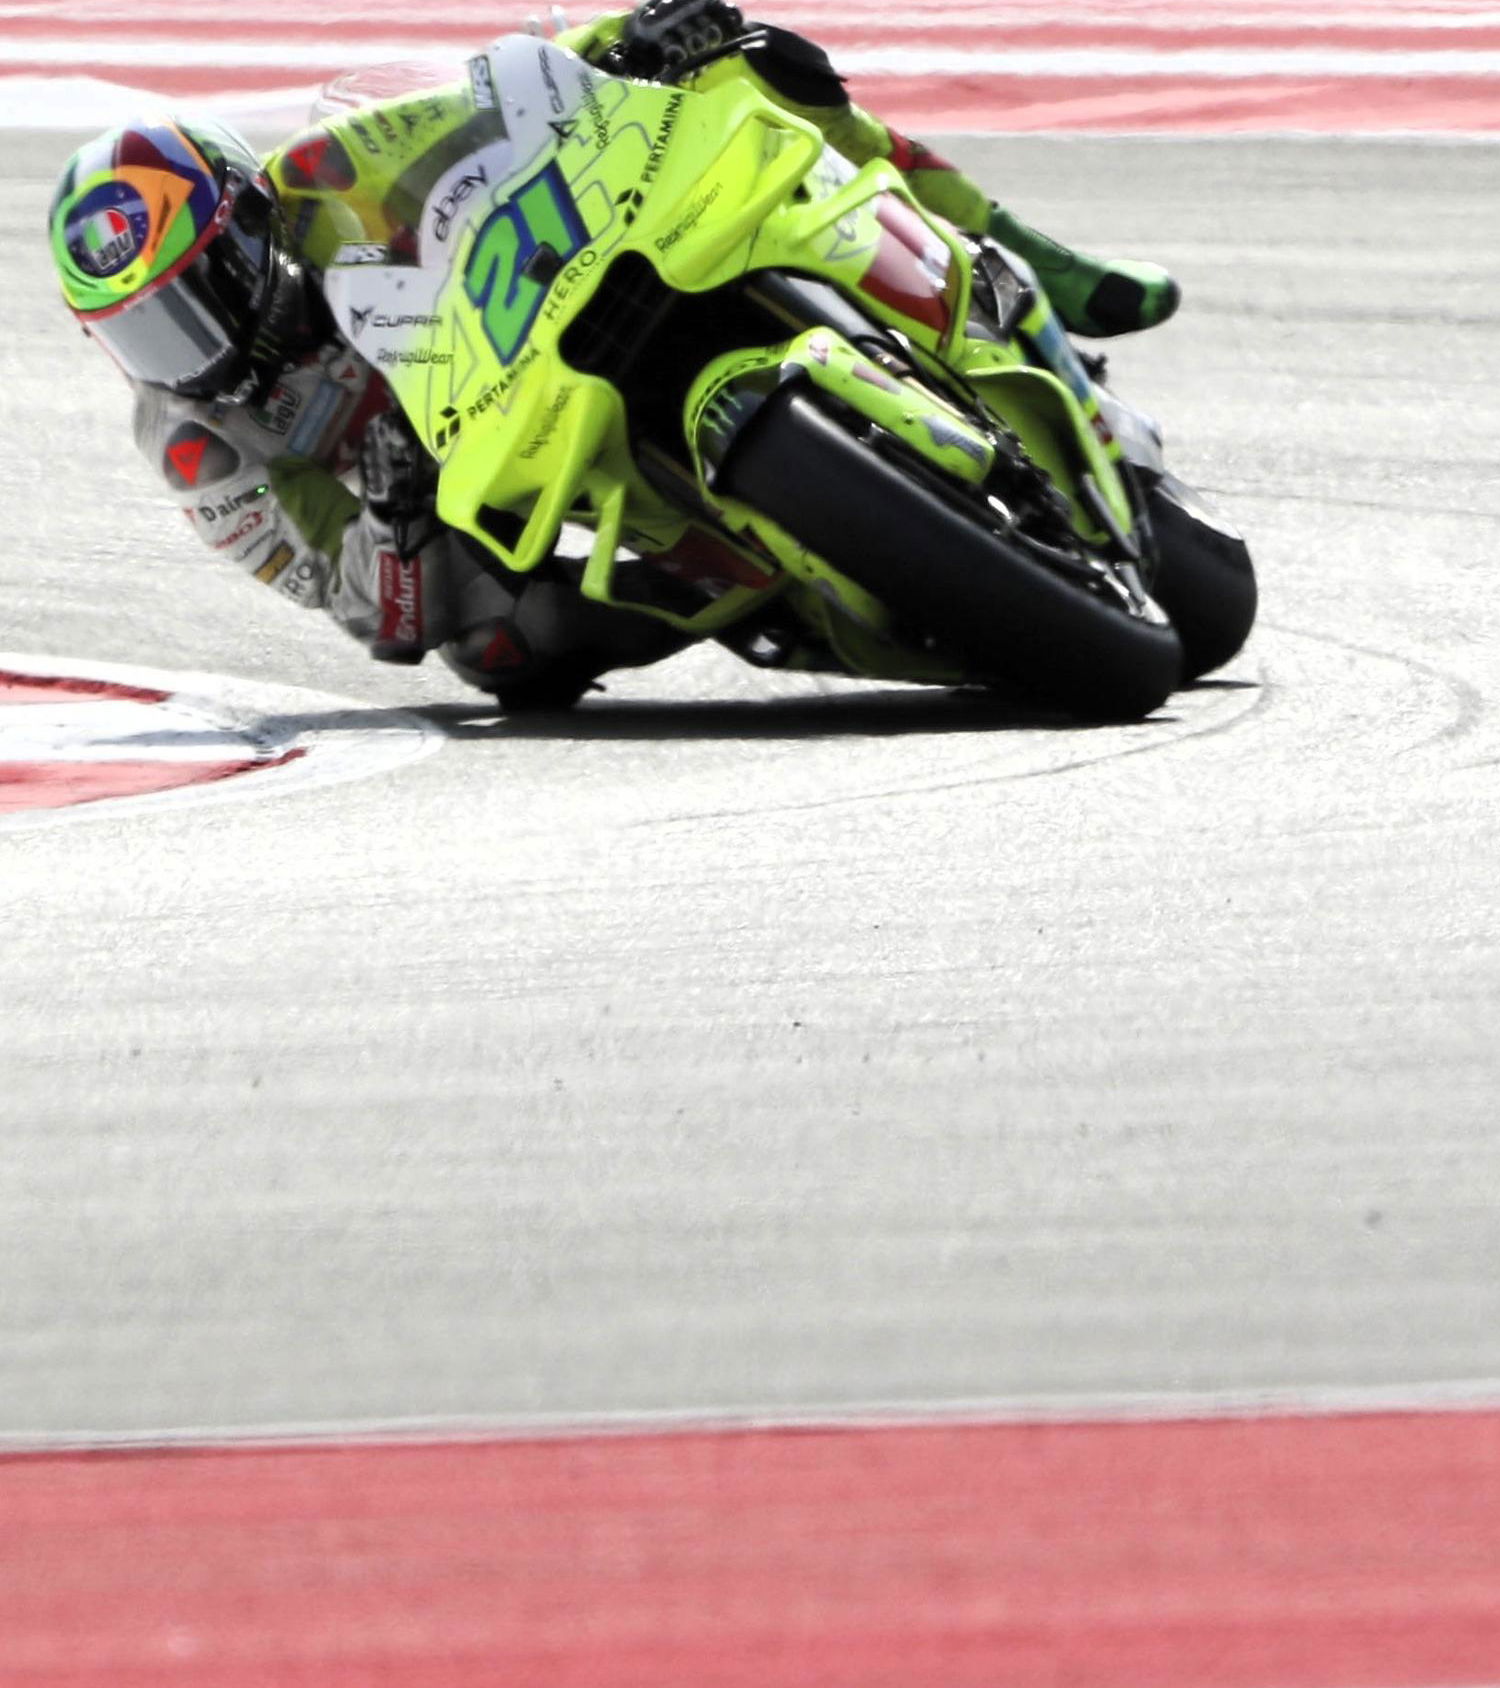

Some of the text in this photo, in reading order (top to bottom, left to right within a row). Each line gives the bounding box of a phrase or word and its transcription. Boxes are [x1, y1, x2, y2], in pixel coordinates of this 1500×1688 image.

[640, 93, 684, 183] PERTAMINA
[432, 163, 488, 242] ebay
[463, 159, 593, 367] 21
[543, 250, 597, 321] HERO
[371, 315, 443, 328] CUPRA
[466, 348, 541, 419] PERTAMINA
[285, 562, 313, 594] RO
